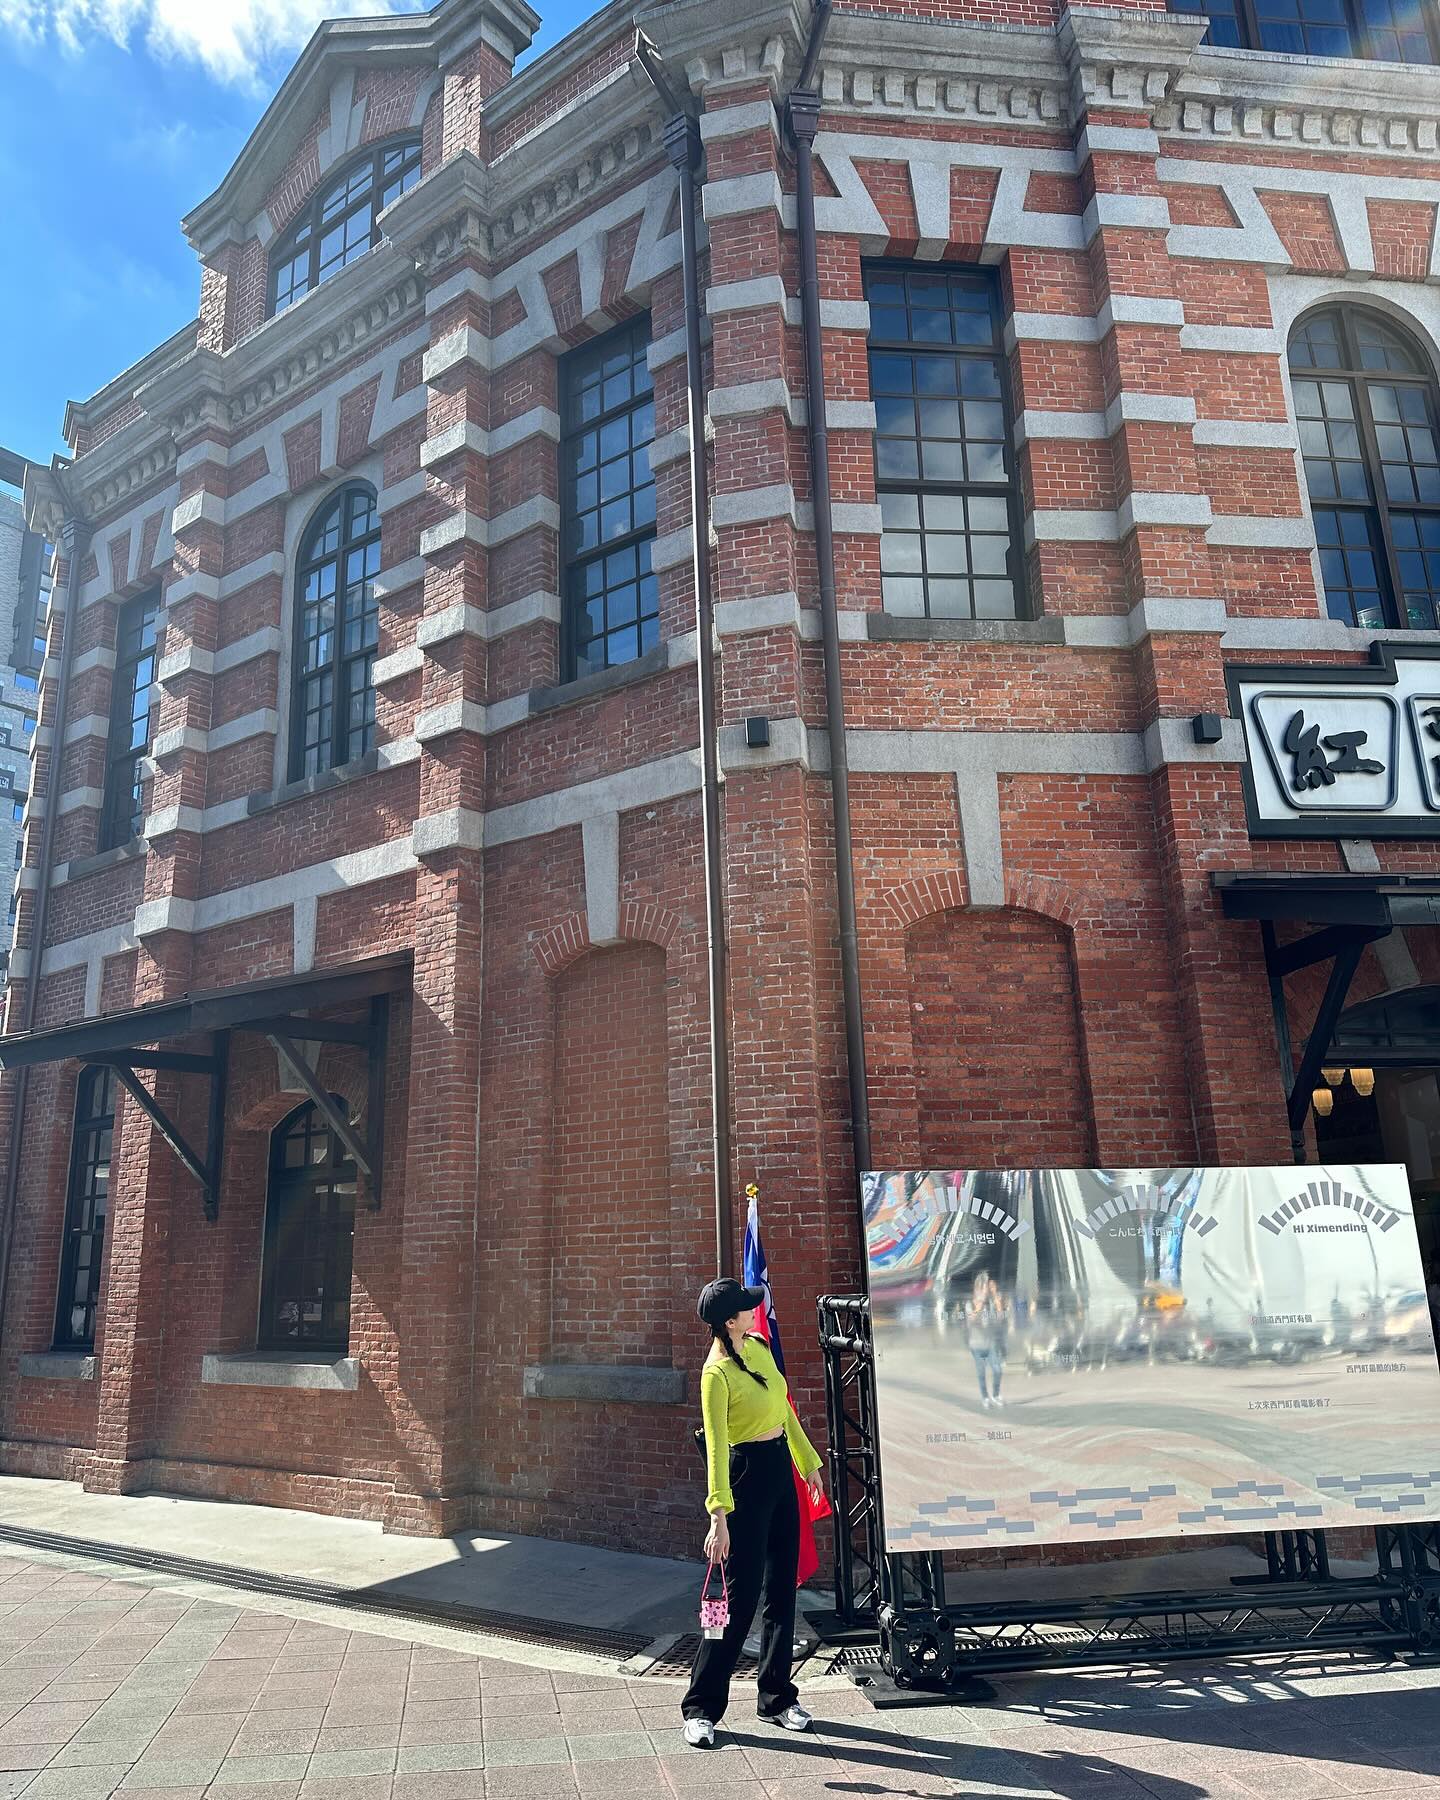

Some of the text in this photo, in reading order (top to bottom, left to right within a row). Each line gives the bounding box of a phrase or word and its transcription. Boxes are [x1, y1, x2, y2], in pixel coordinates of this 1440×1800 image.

[1293, 1223, 1368, 1233] Hi Ximending
[968, 1232, 996, 1245] 시먼딩
